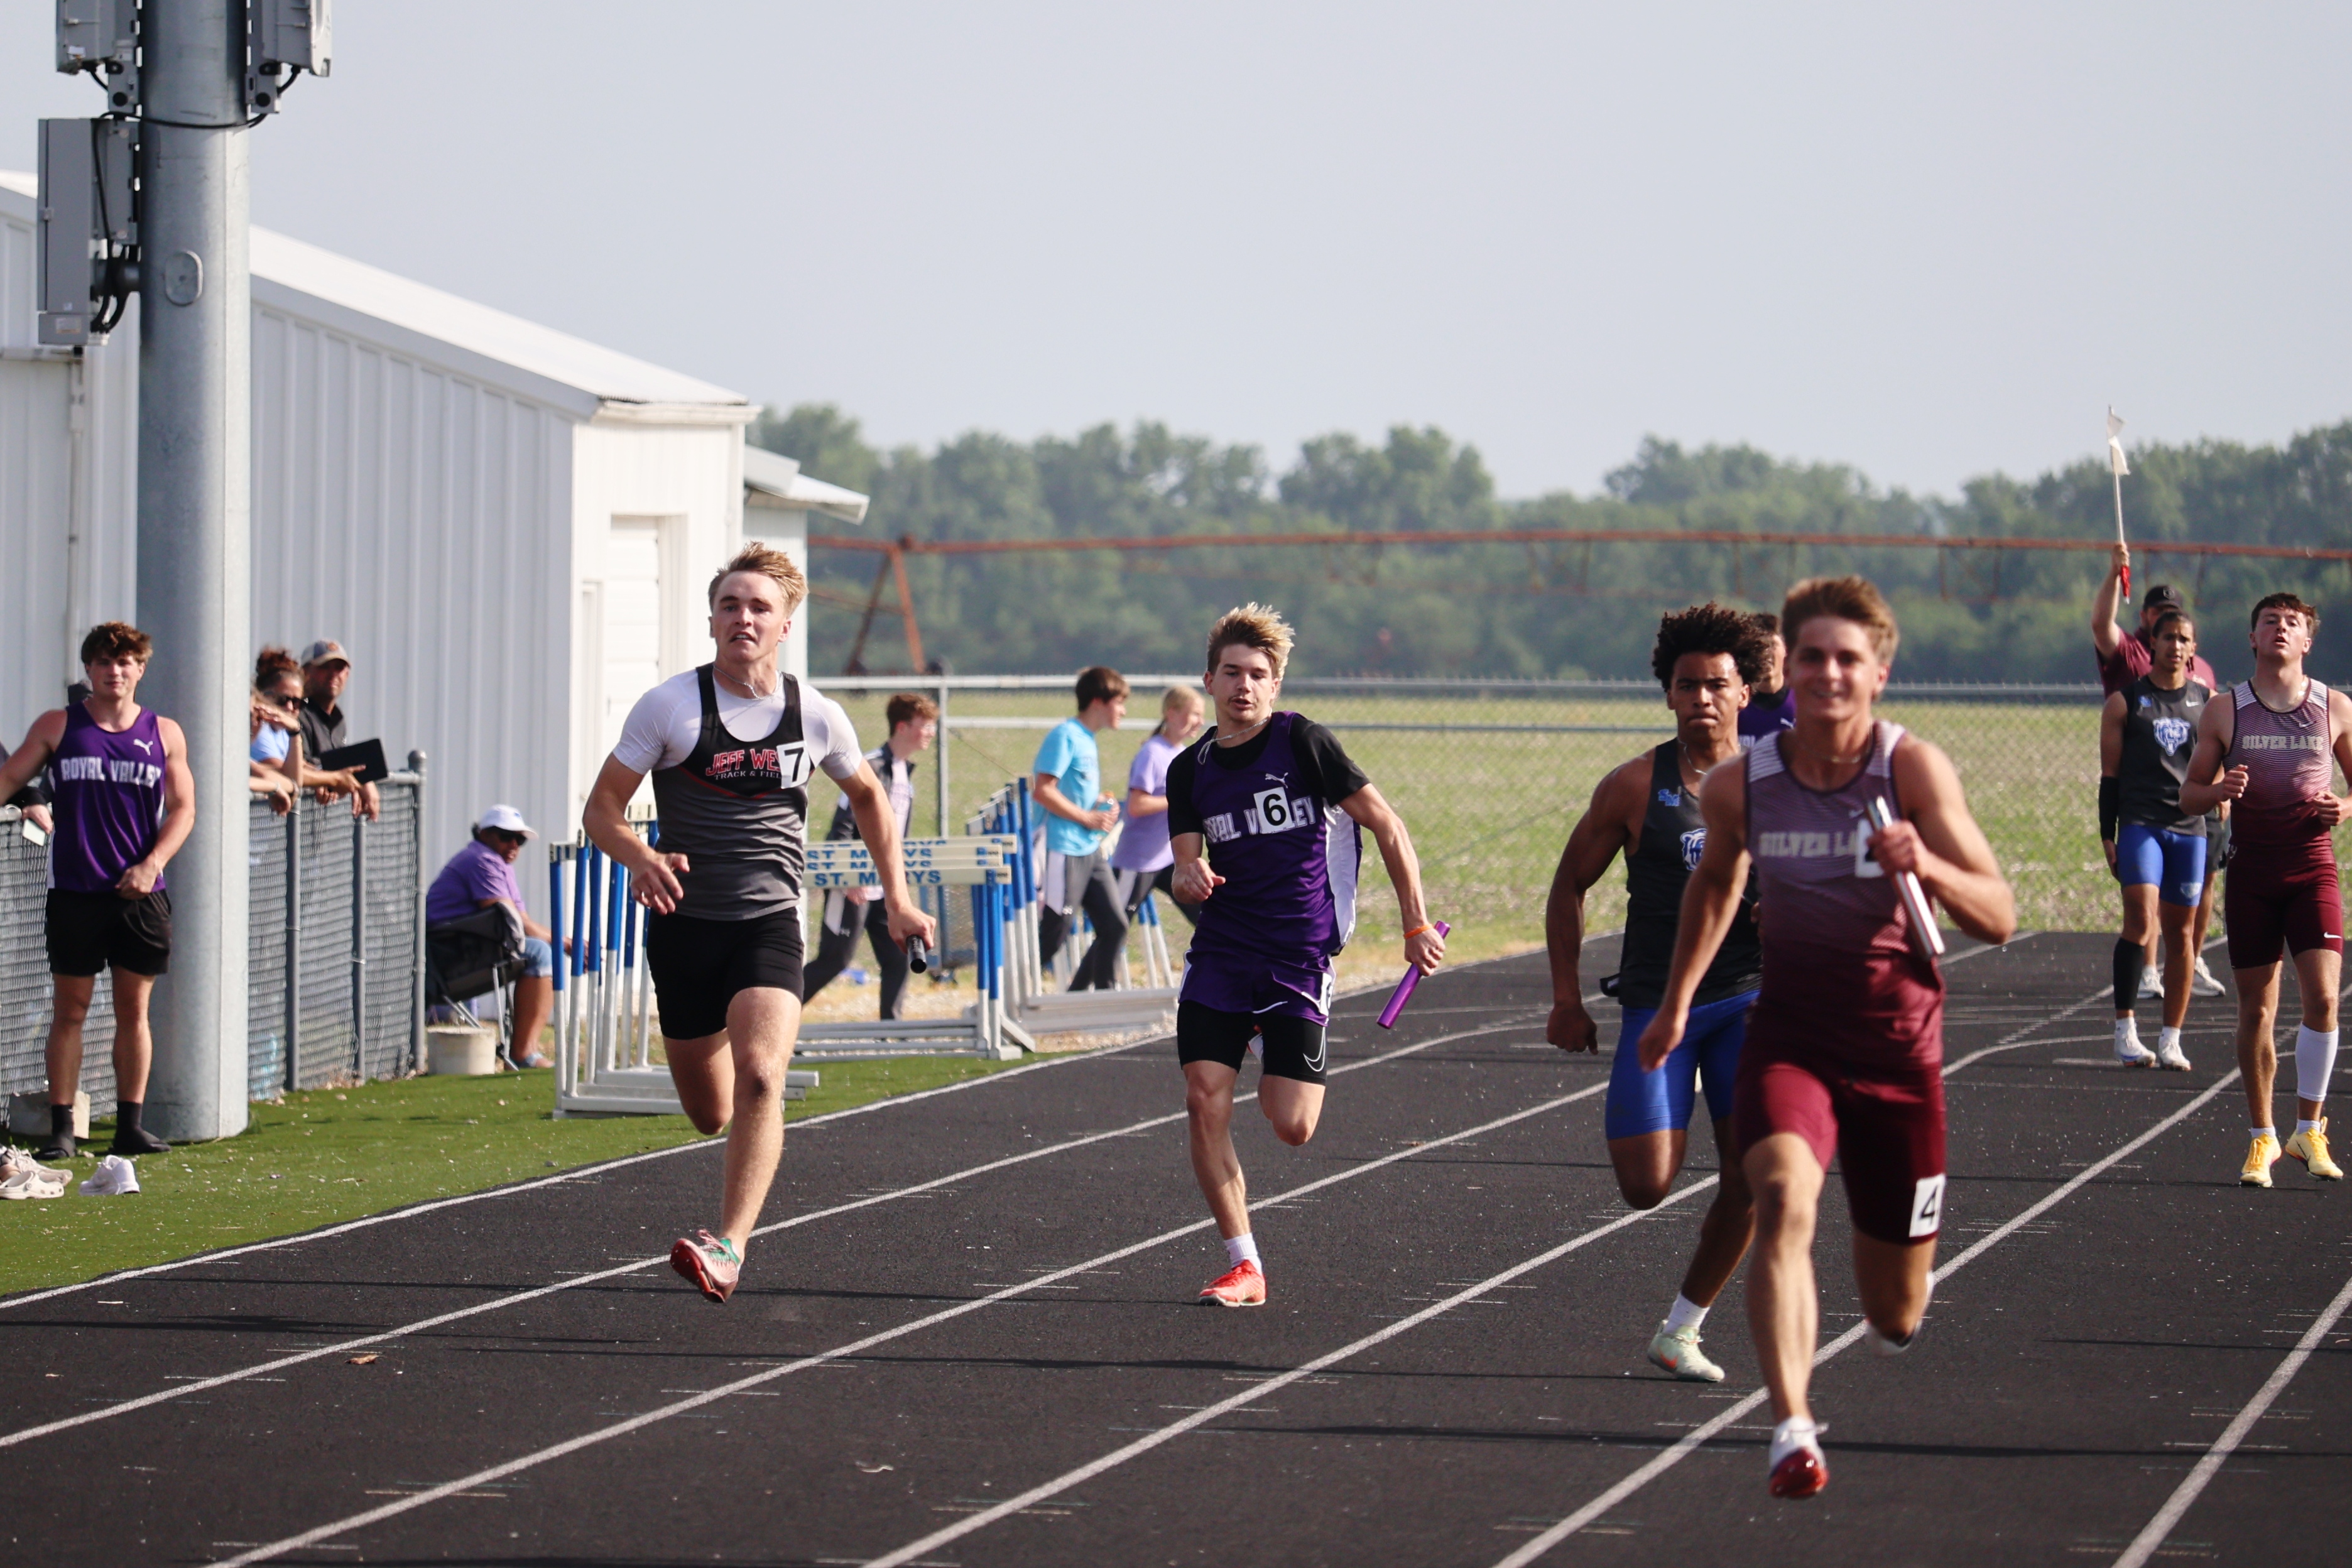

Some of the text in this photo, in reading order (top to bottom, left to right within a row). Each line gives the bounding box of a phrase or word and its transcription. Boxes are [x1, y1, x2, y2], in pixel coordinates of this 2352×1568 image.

[2241, 735, 2324, 751] SILVER LAKE
[60, 756, 162, 789] ROYAL VALLEY
[705, 748, 781, 776] JEFF WE
[714, 771, 746, 780] TRACK
[760, 771, 781, 780] FIEL
[784, 747, 804, 783] 7
[1203, 796, 1316, 843] YAL VEY
[1263, 793, 1287, 826] 6
[850, 847, 932, 859] MYS
[1759, 831, 1830, 858] SILVER
[1834, 830, 1858, 858] LA
[814, 870, 942, 886] ST. MYS
[1919, 1183, 1939, 1228] 4
